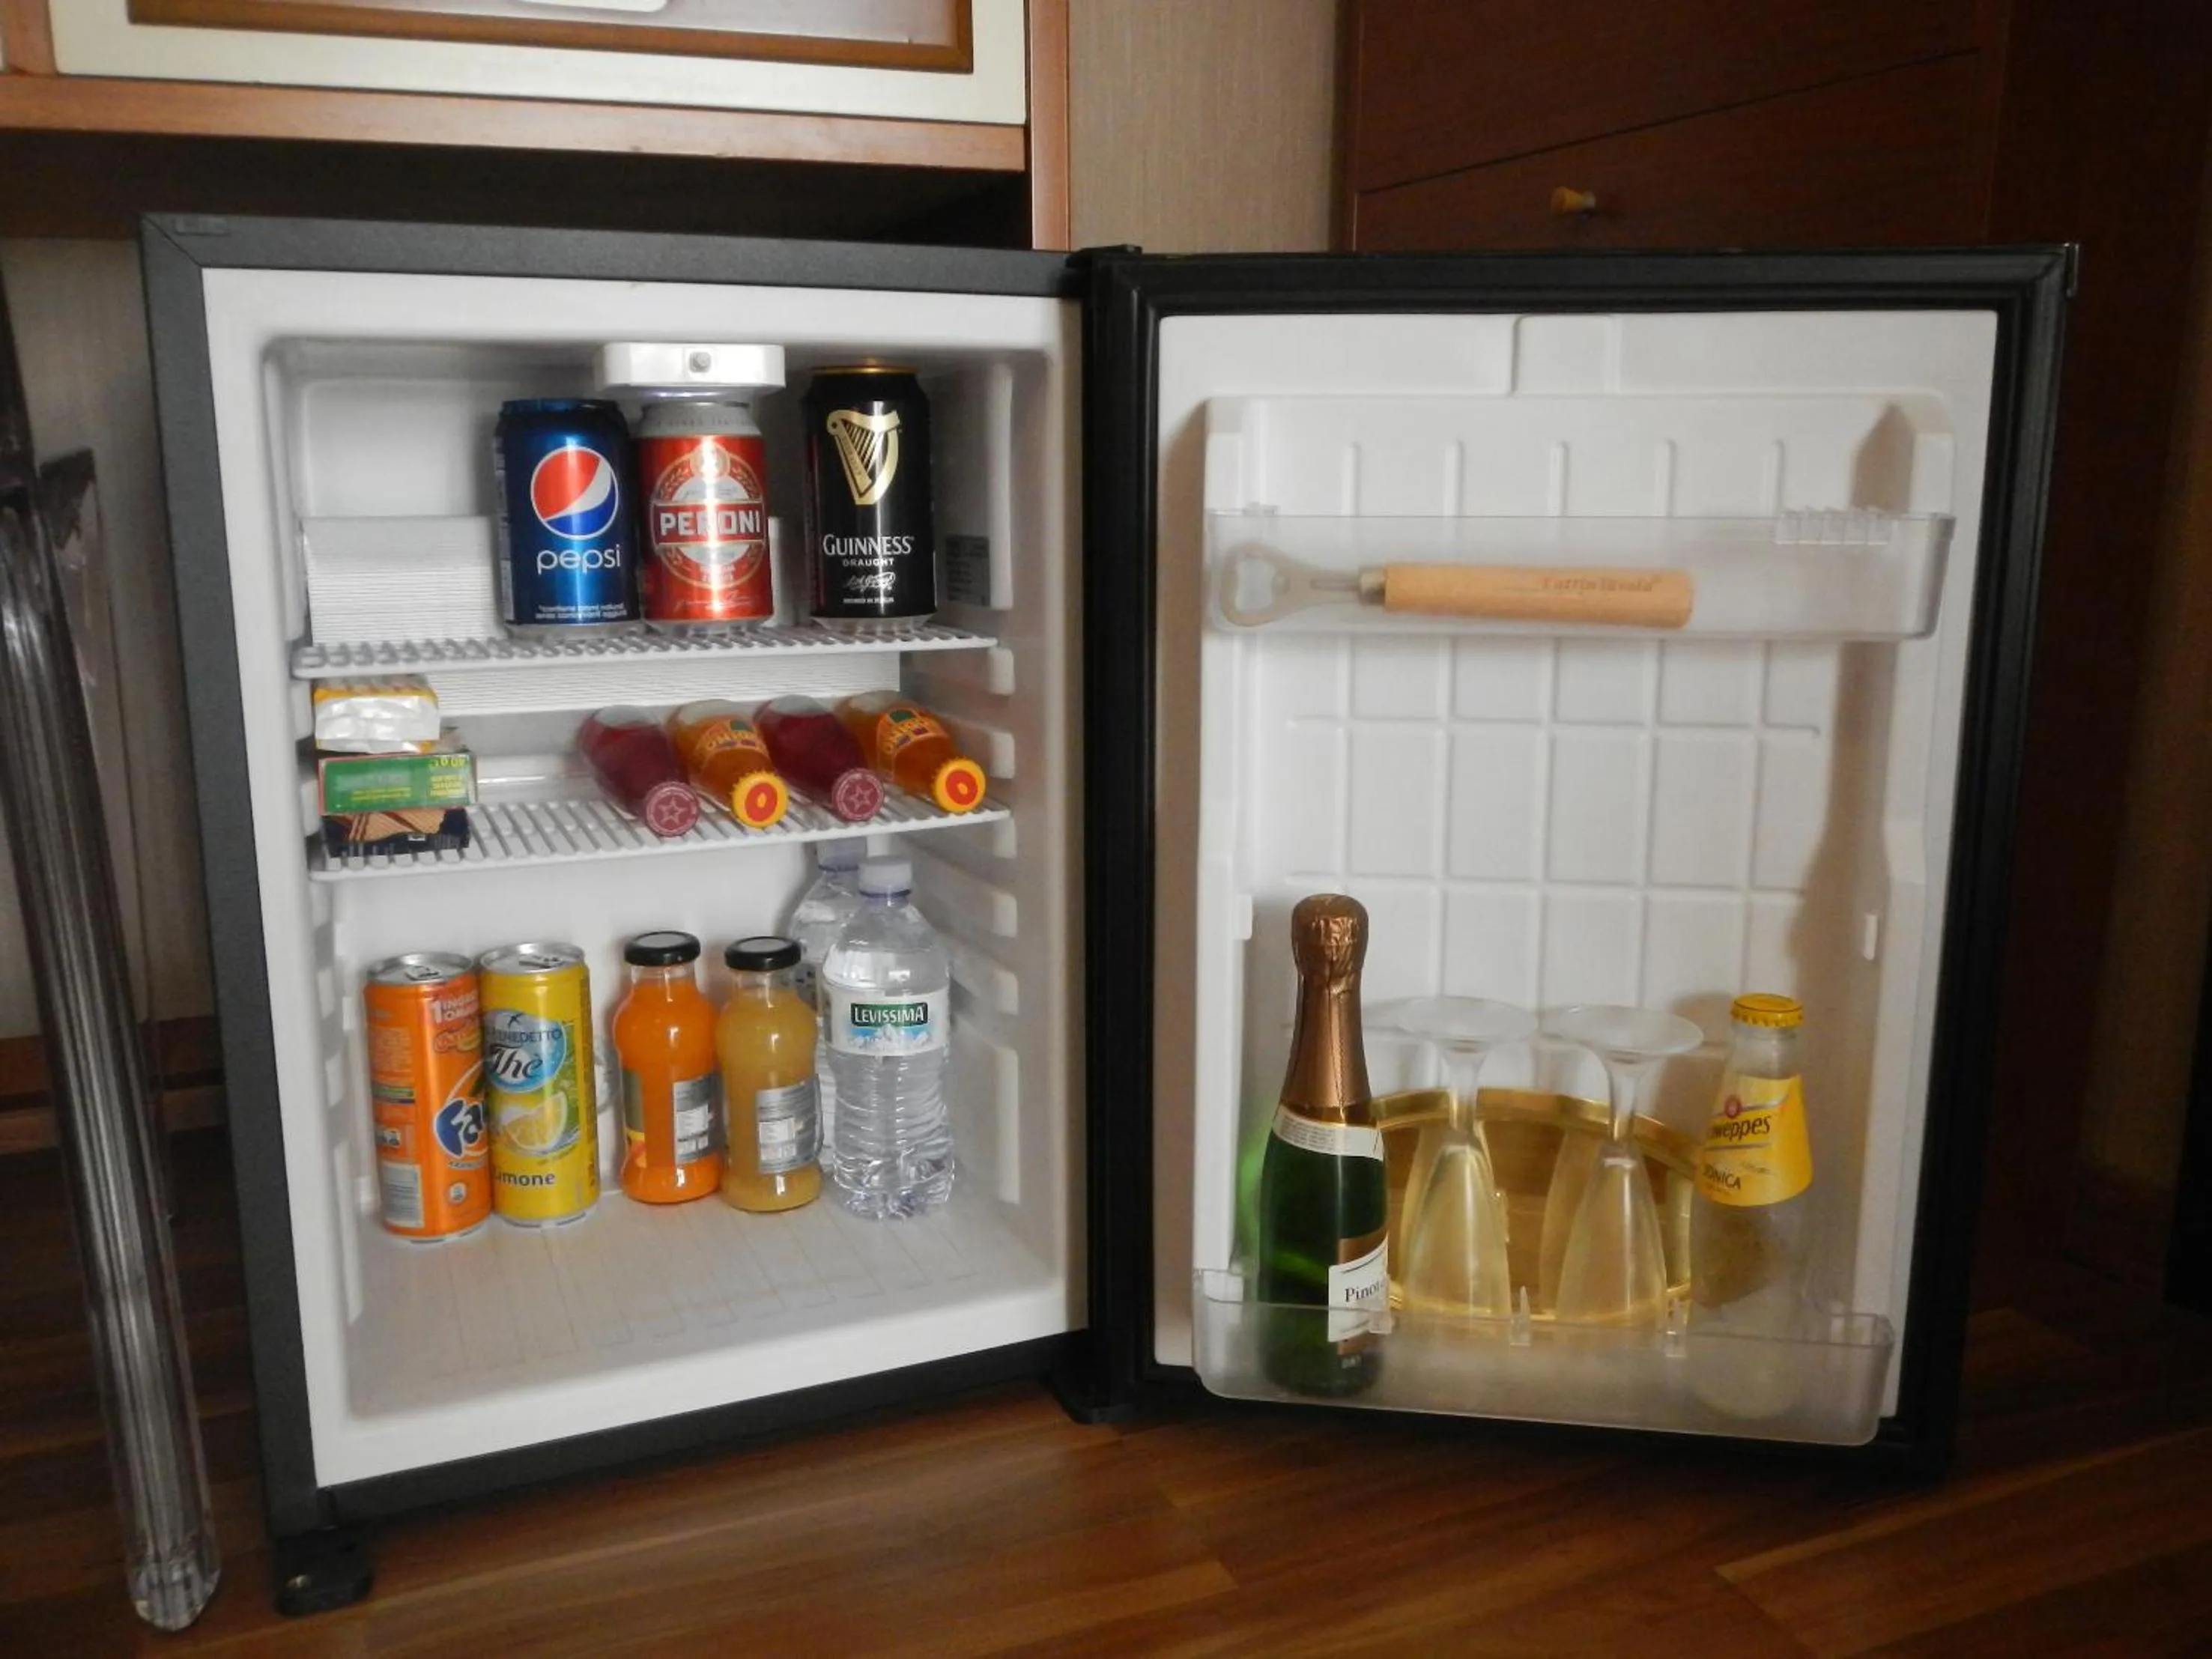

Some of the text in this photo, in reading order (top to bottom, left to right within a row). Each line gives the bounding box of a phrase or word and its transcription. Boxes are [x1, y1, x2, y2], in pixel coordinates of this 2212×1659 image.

[659, 509, 760, 536] PERONI
[823, 534, 911, 556] GUINNESS
[536, 544, 621, 575] pepsi
[842, 557, 894, 567] DRAUGHT
[855, 1006, 924, 1024] LEVISSIMA
[495, 1171, 555, 1187] imone
